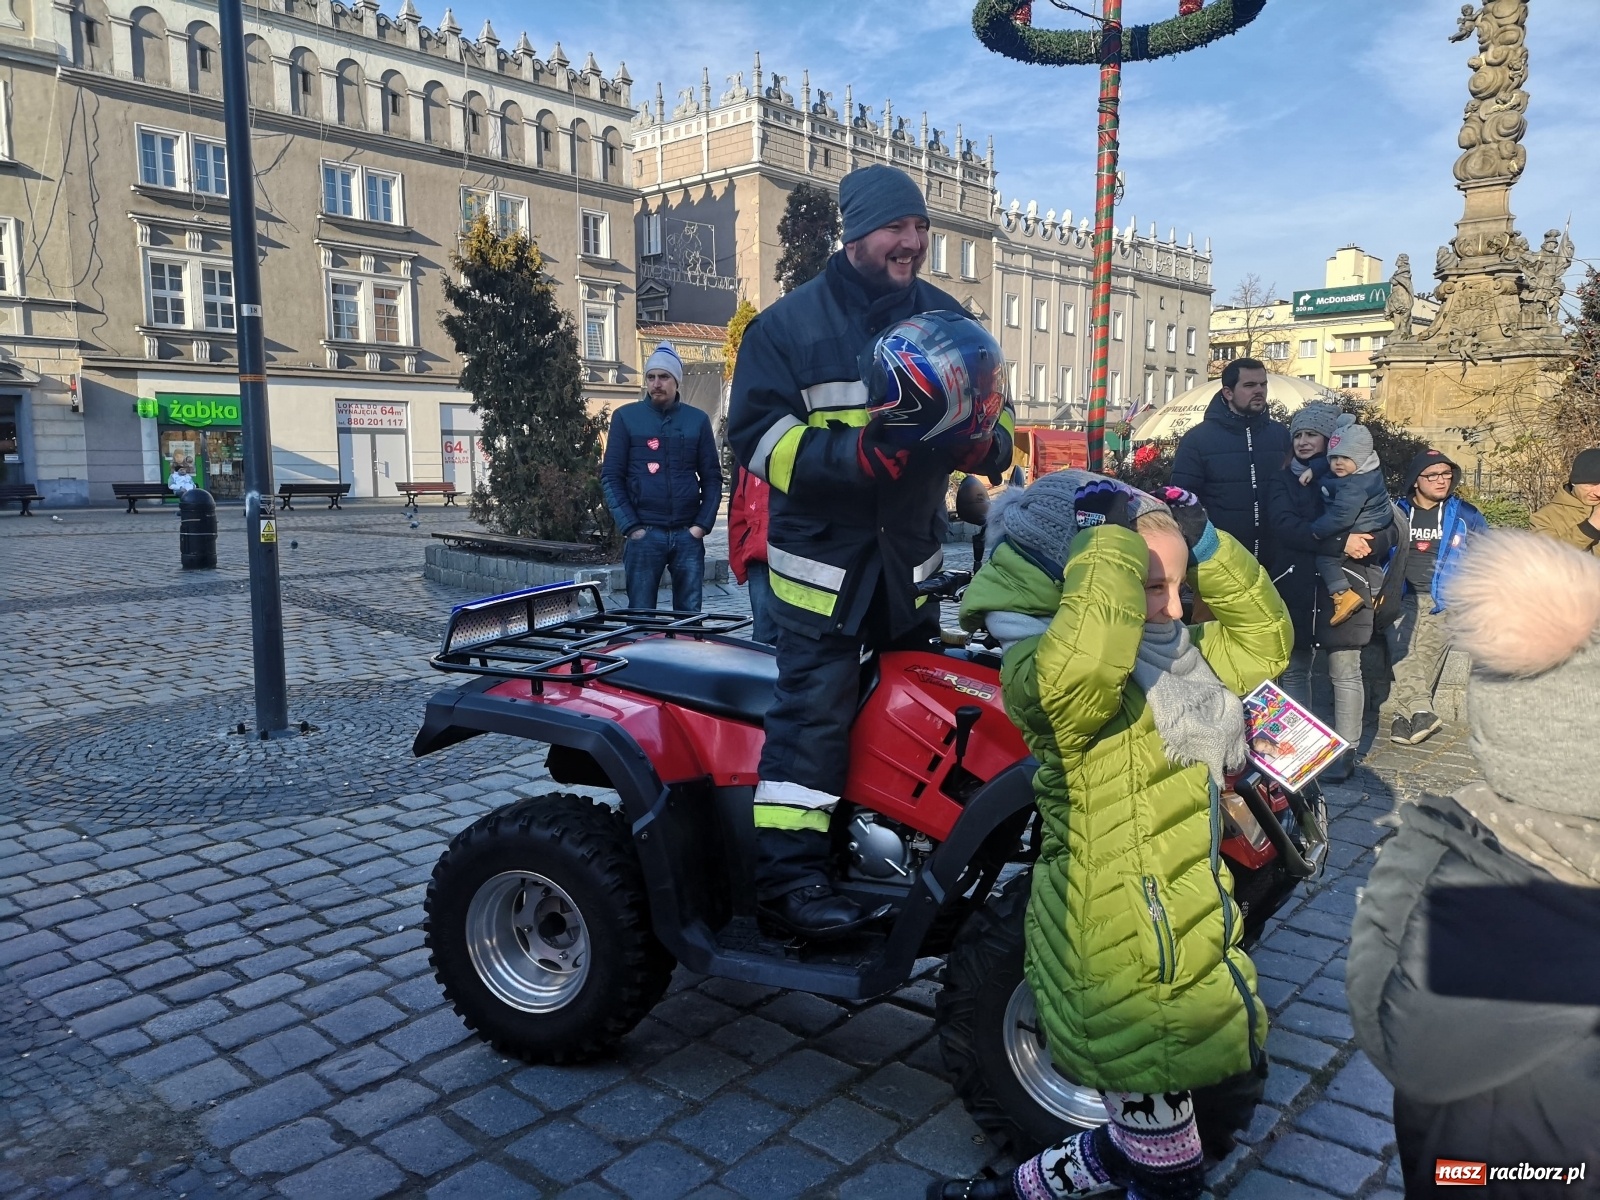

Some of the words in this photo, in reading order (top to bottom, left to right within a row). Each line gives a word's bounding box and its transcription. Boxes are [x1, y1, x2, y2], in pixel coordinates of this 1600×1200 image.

[1316, 293, 1366, 305] McDonald's
[170, 400, 238, 419] żabka
[1186, 404, 1208, 412] RACI
[347, 418, 364, 426] 880
[367, 418, 384, 426] 201
[1410, 528, 1443, 540] PAGA
[954, 685, 992, 700] 300
